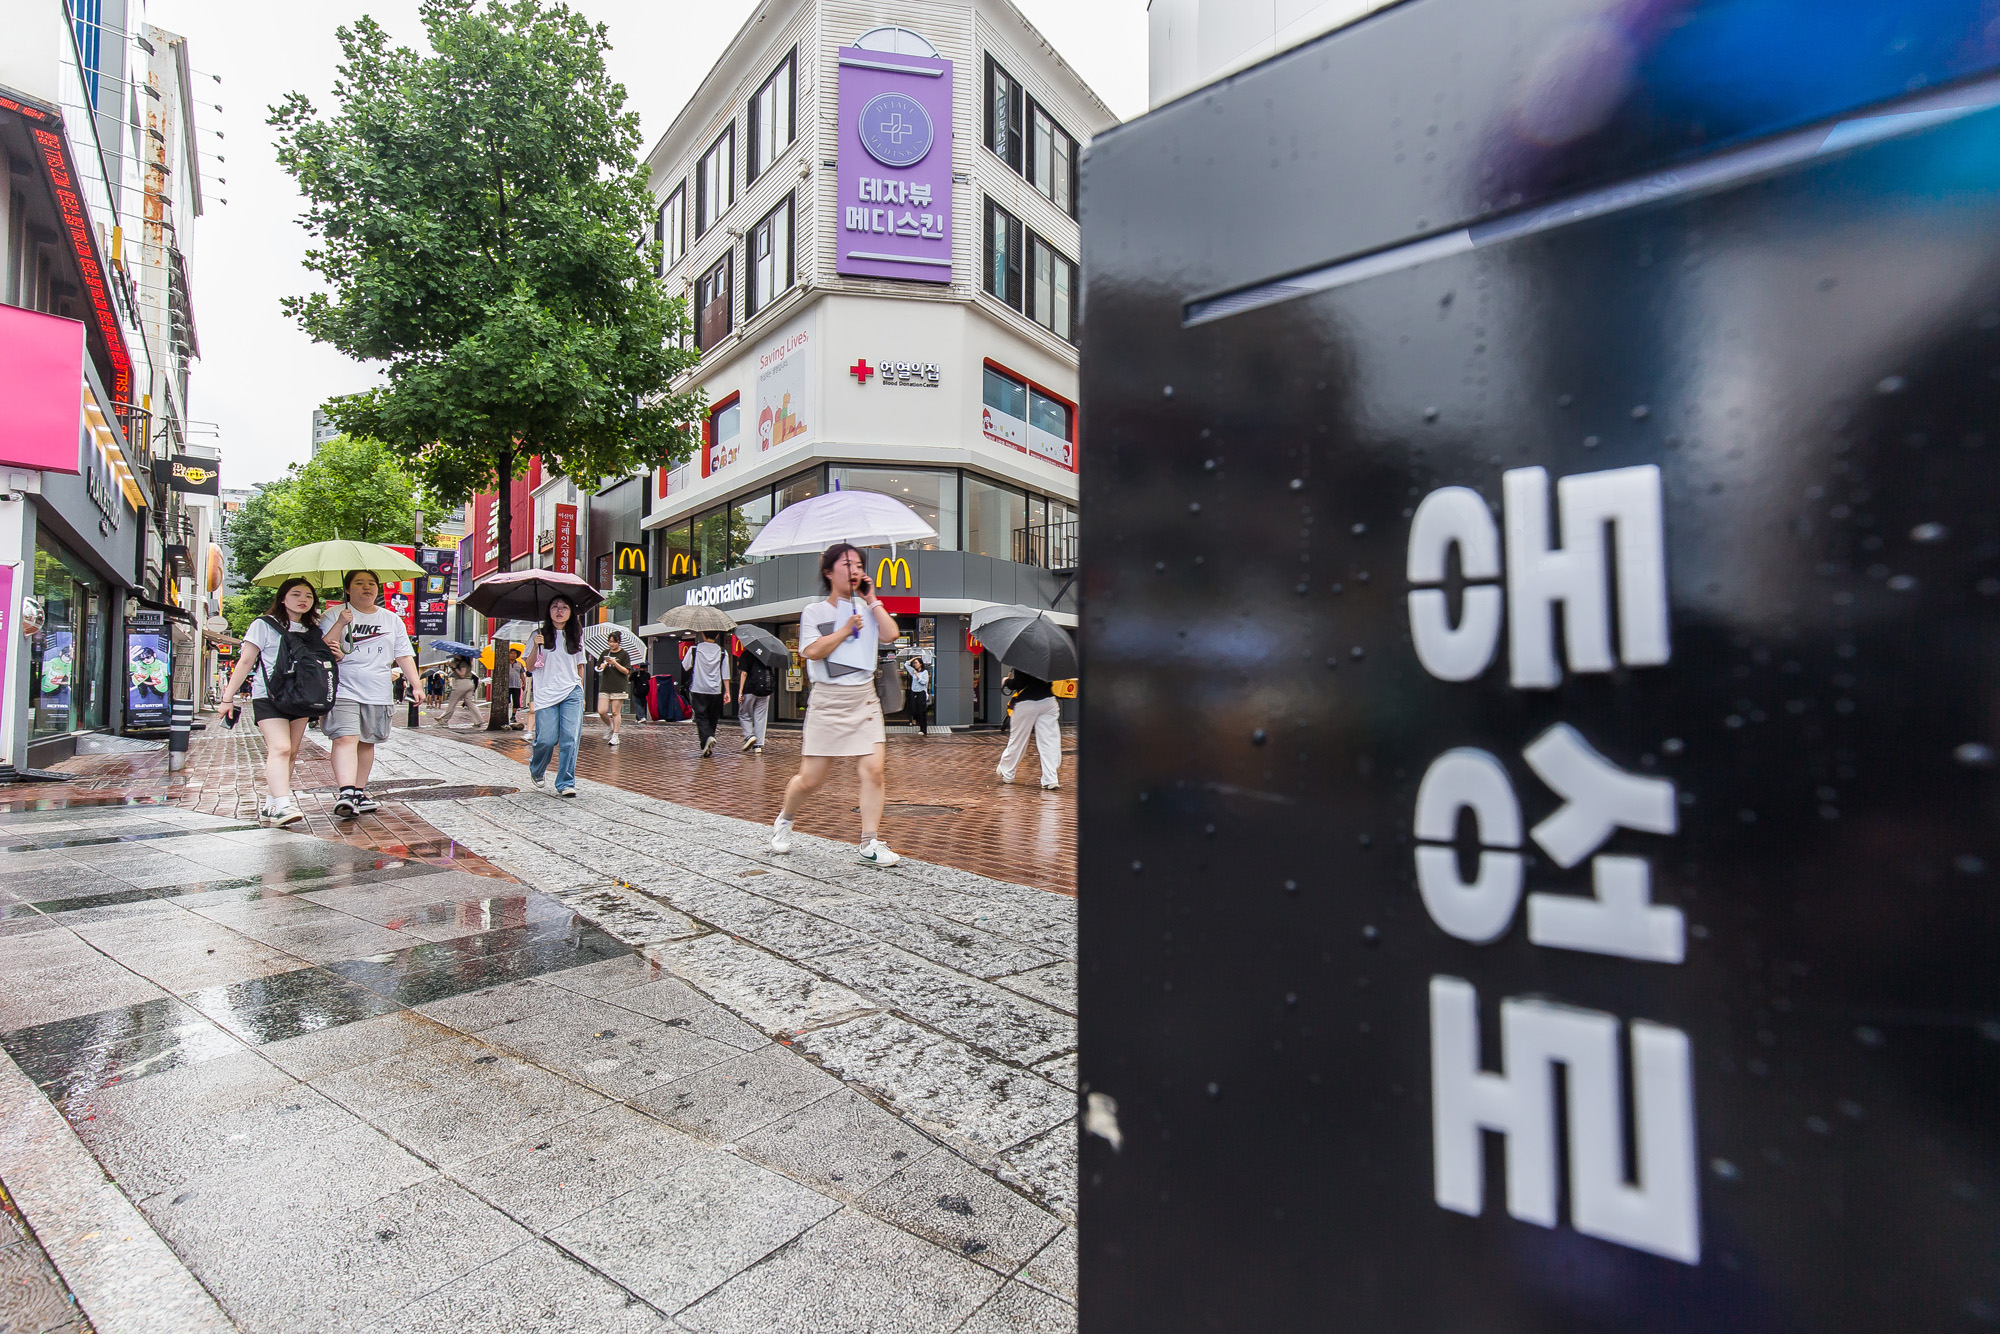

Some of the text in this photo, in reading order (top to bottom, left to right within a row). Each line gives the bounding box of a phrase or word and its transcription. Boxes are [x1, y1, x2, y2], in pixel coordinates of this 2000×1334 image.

[859, 177, 933, 208] 데자뷰
[845, 206, 944, 240] 메디스킨
[760, 330, 809, 370] Saving Lives,
[686, 577, 756, 606] McDonald's
[353, 624, 381, 634] NIKE
[353, 646, 383, 654] AIR
[1407, 464, 1700, 1265] 동성로
